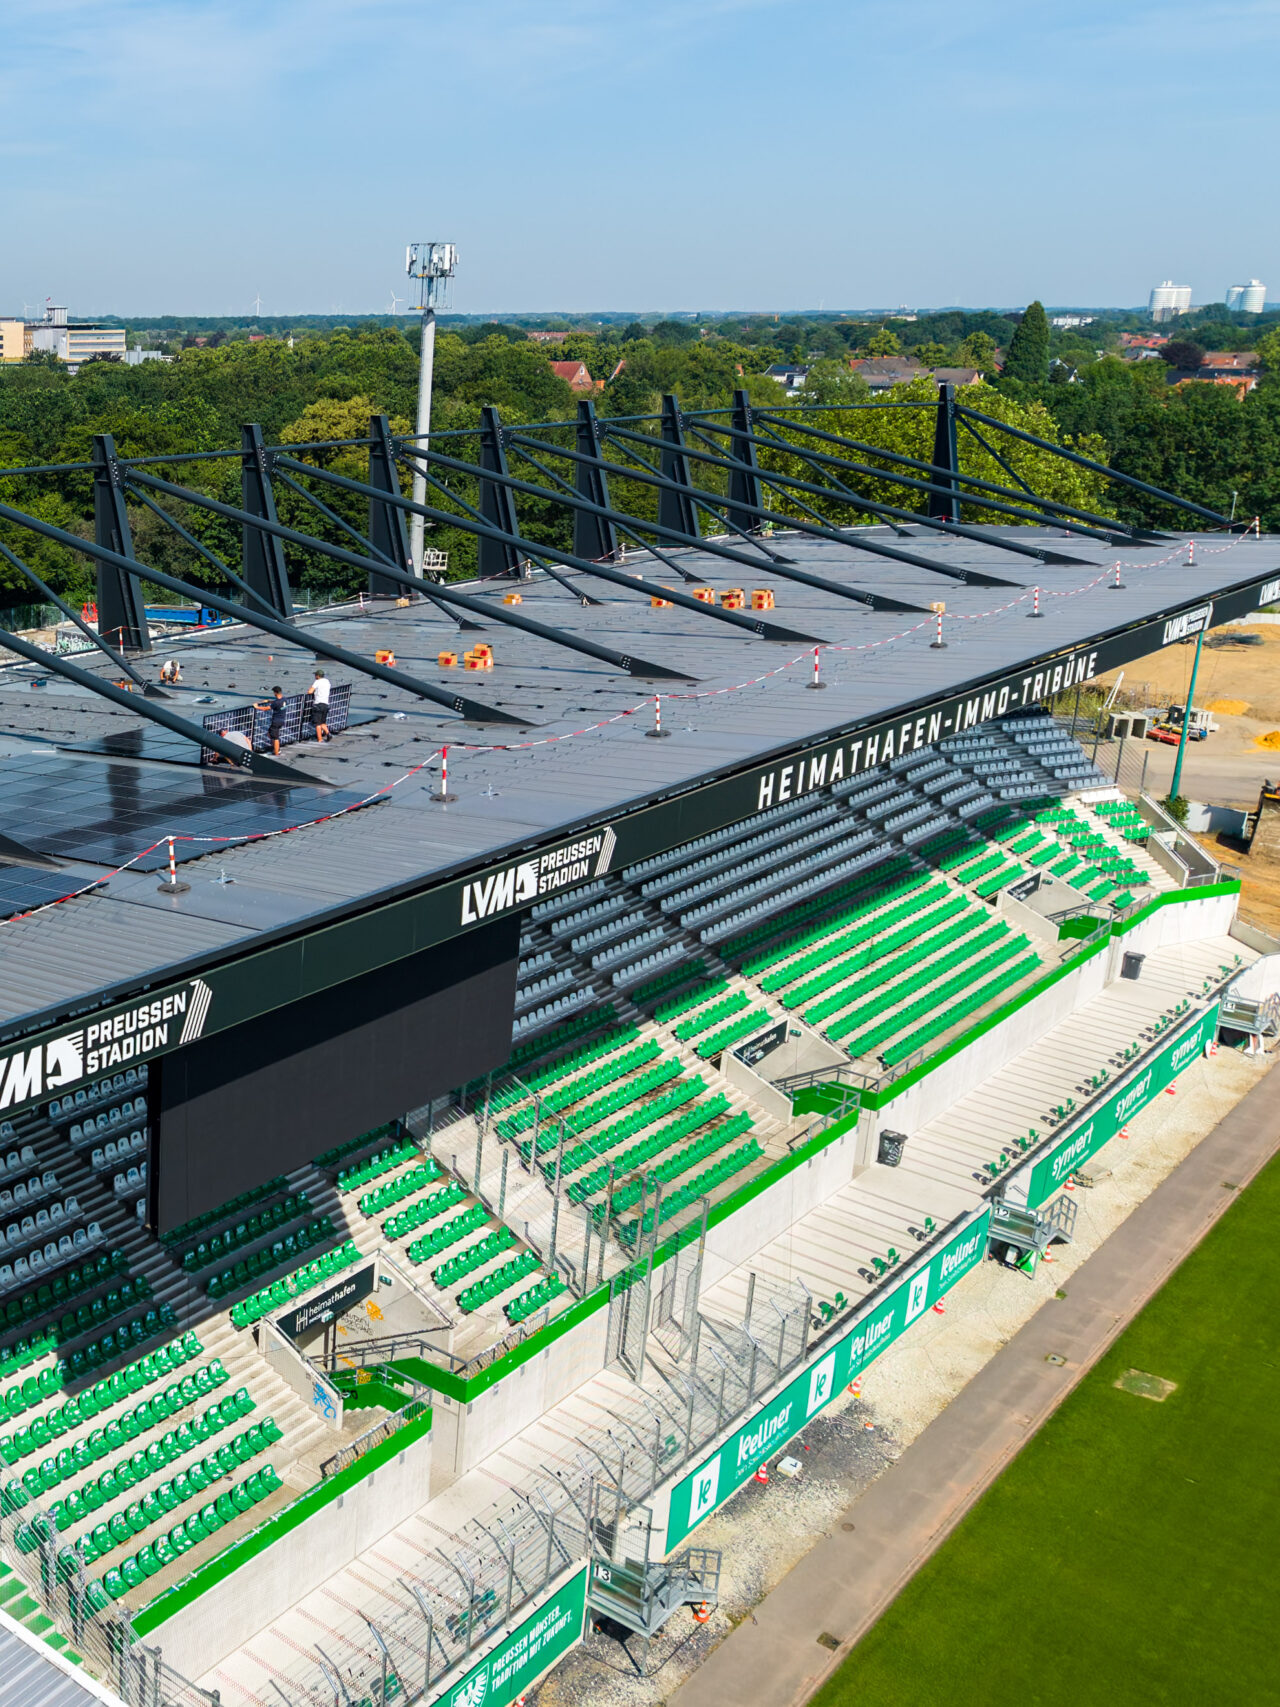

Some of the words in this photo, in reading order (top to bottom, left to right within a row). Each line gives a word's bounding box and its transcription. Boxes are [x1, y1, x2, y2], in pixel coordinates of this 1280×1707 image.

[757, 652, 1098, 810] HEIMATHAFEN-IMMO-TRIBÜNE
[539, 859, 589, 894] STADION
[540, 834, 602, 873] PREUSSEN
[461, 867, 516, 926] LVM
[86, 991, 187, 1049] PREUSSEN
[86, 1023, 168, 1075] STADION
[1115, 1068, 1152, 1122] synvert
[1052, 1121, 1094, 1180] synvert
[309, 1283, 356, 1317] heimathafen
[594, 1564, 610, 1582] 13
[492, 1634, 528, 1677] PREUSSEN
[492, 1650, 528, 1693] TRADITION
